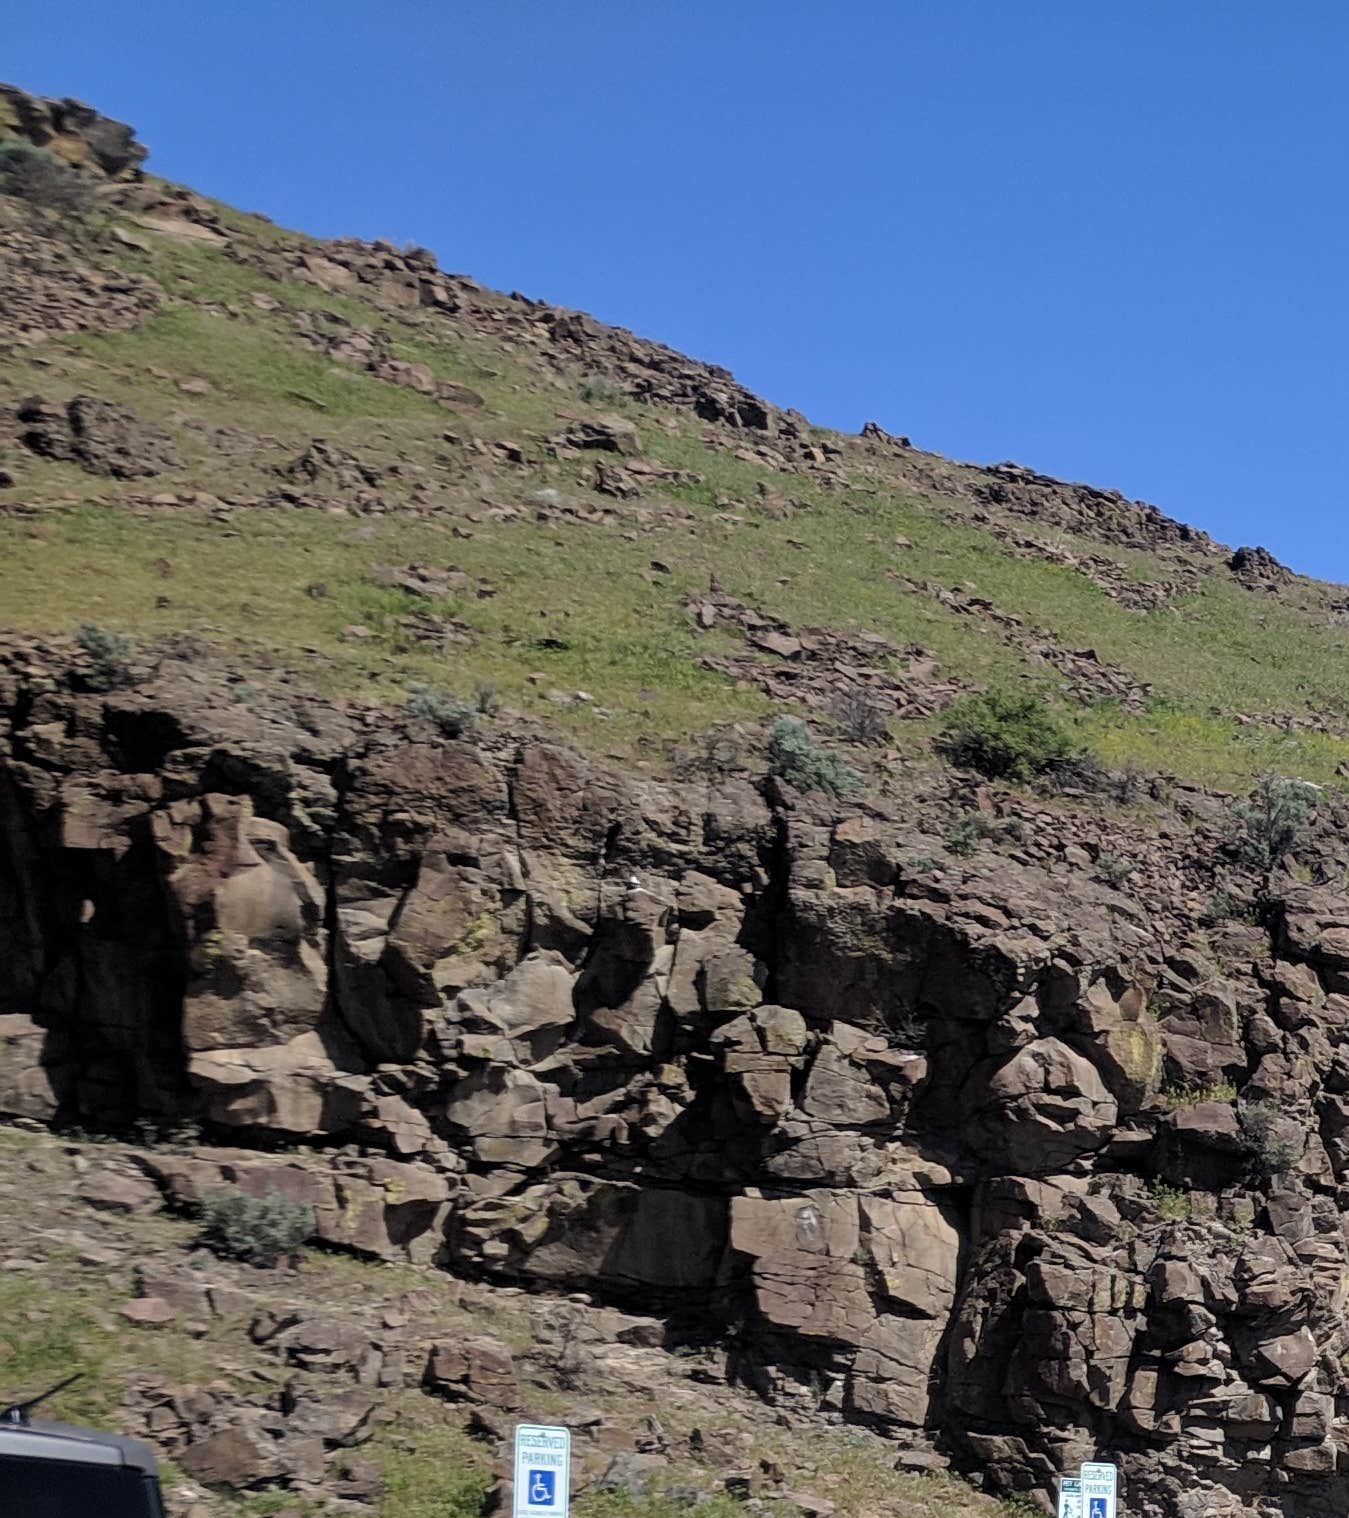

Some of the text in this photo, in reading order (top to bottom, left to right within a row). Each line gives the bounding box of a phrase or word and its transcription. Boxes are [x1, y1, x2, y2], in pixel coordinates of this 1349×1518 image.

[519, 1434, 565, 1449] RESERVED
[521, 1451, 563, 1466] PARKING
[1083, 1469, 1113, 1481] RESERVED
[1084, 1483, 1112, 1495] PARKING
